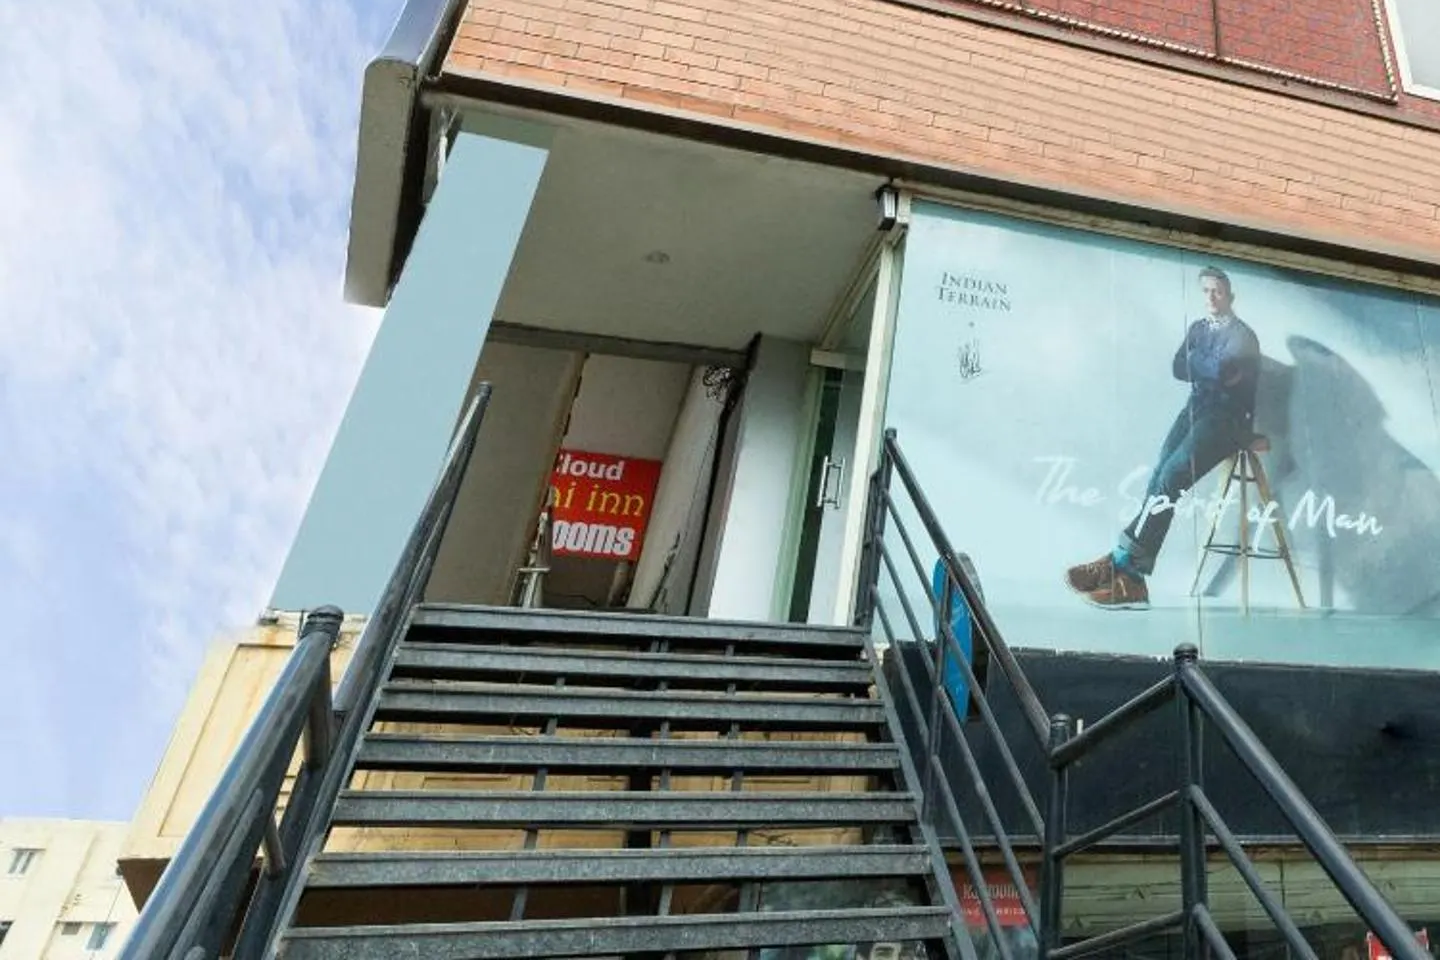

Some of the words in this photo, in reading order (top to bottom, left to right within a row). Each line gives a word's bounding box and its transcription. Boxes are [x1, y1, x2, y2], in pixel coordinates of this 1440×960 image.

[942, 271, 1007, 295] INDIAN
[935, 286, 1012, 312] TERRAIN
[586, 483, 645, 517] inn
[1032, 456, 1107, 507] The
[1246, 500, 1279, 552] of
[1288, 489, 1384, 538] Man
